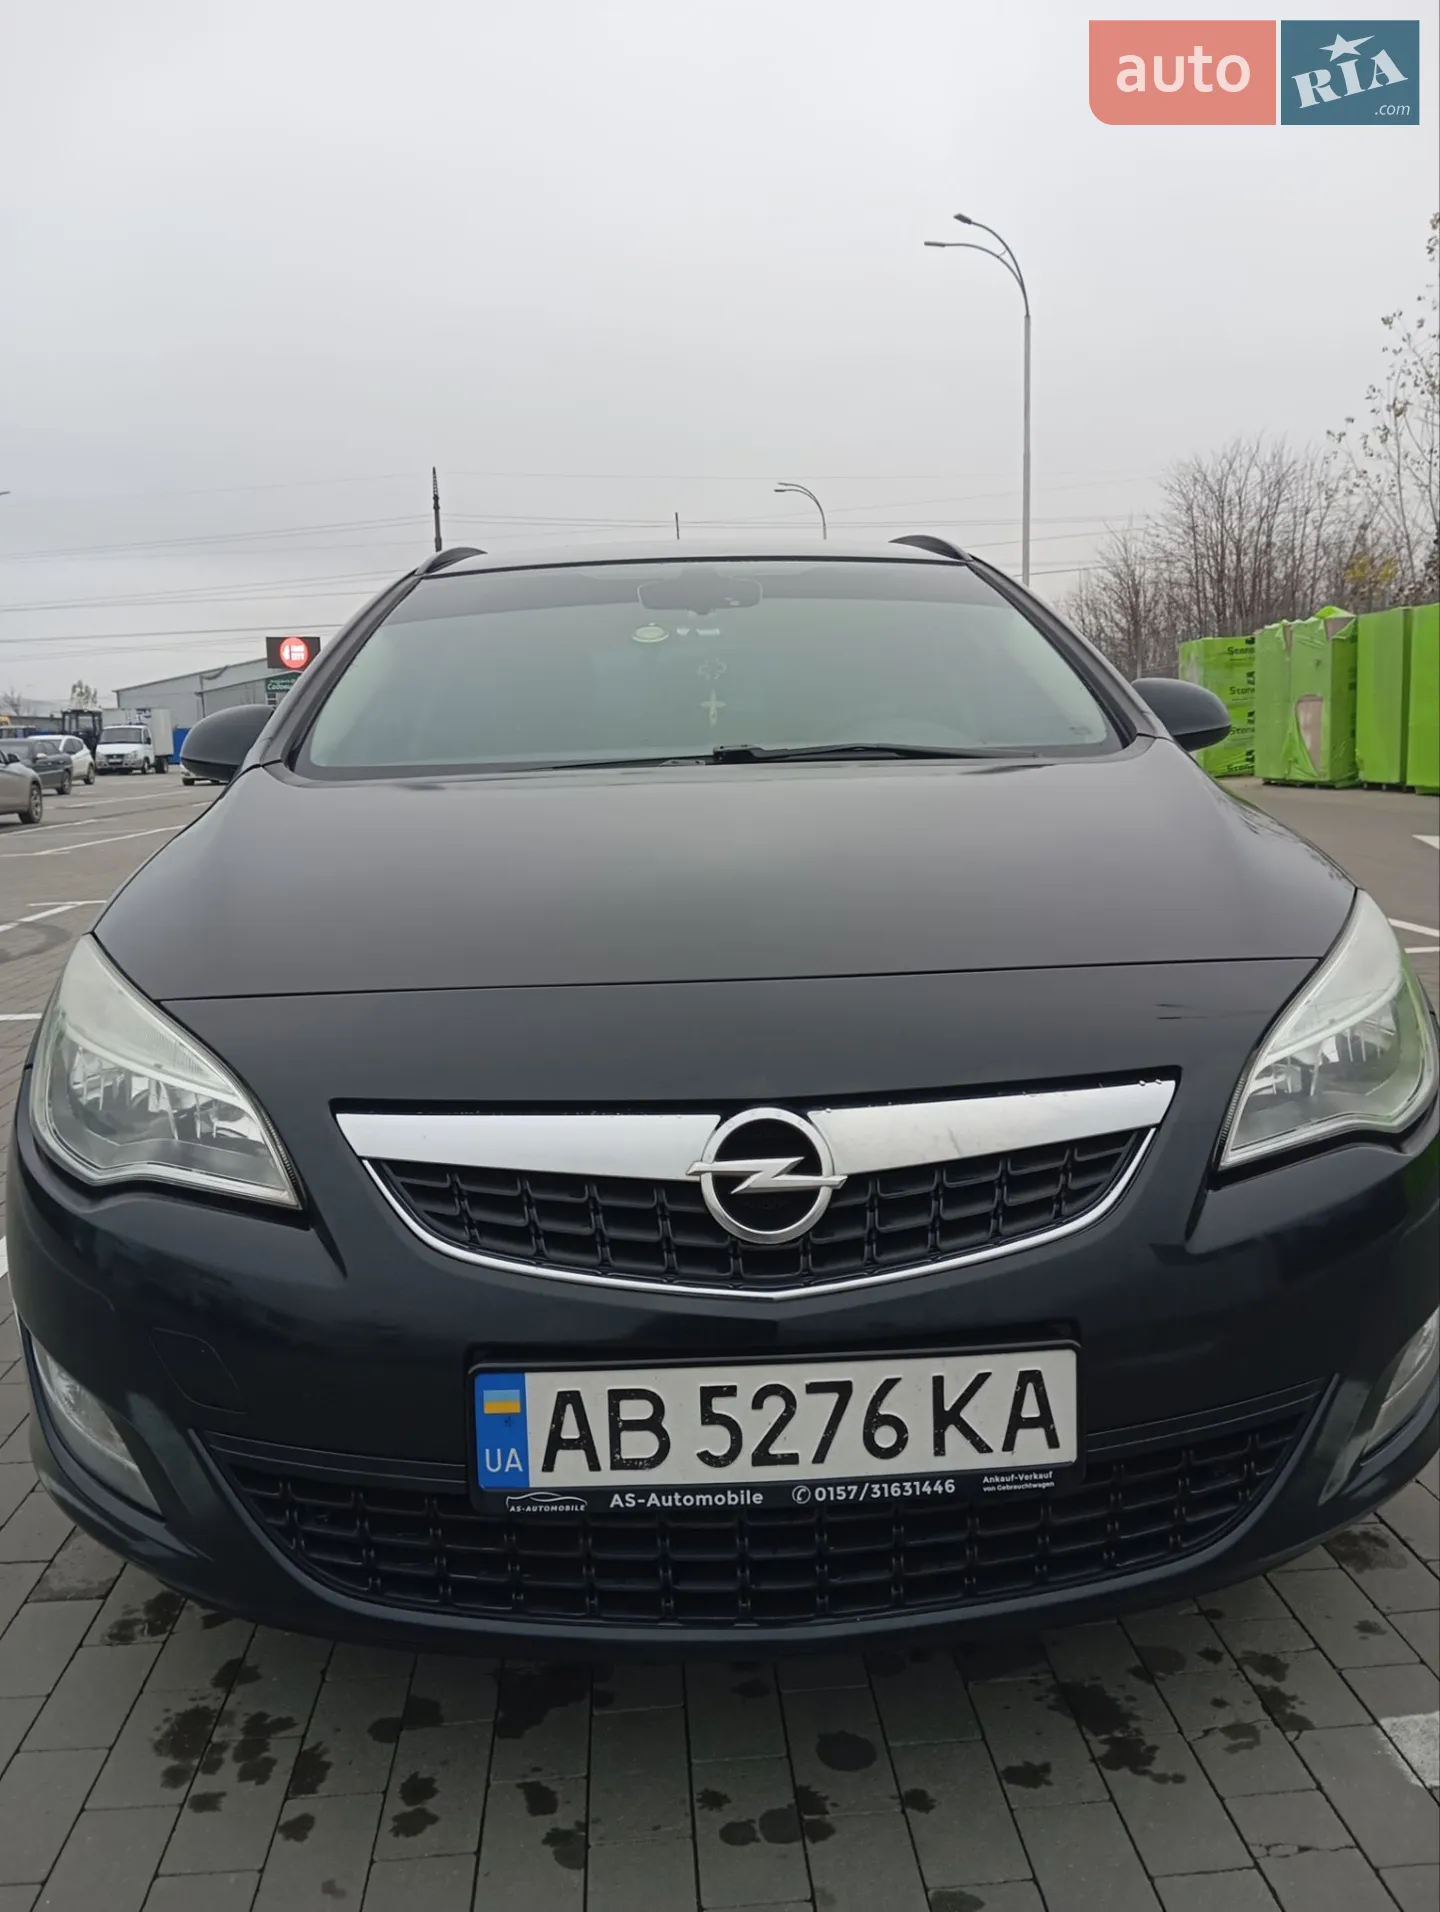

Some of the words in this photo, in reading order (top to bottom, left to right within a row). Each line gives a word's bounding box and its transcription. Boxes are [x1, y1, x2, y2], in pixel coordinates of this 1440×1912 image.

[541, 1388, 672, 1473] AB
[695, 1377, 911, 1468] 5276
[932, 1369, 1060, 1457] KA
[485, 1448, 524, 1473] UA
[982, 1471, 1053, 1484] Ankauf-Verkauf
[609, 1490, 764, 1509] AS-Automobile
[814, 1479, 956, 1501] 0157/31631446
[509, 1504, 586, 1512] AS-AUTOMOBILE
